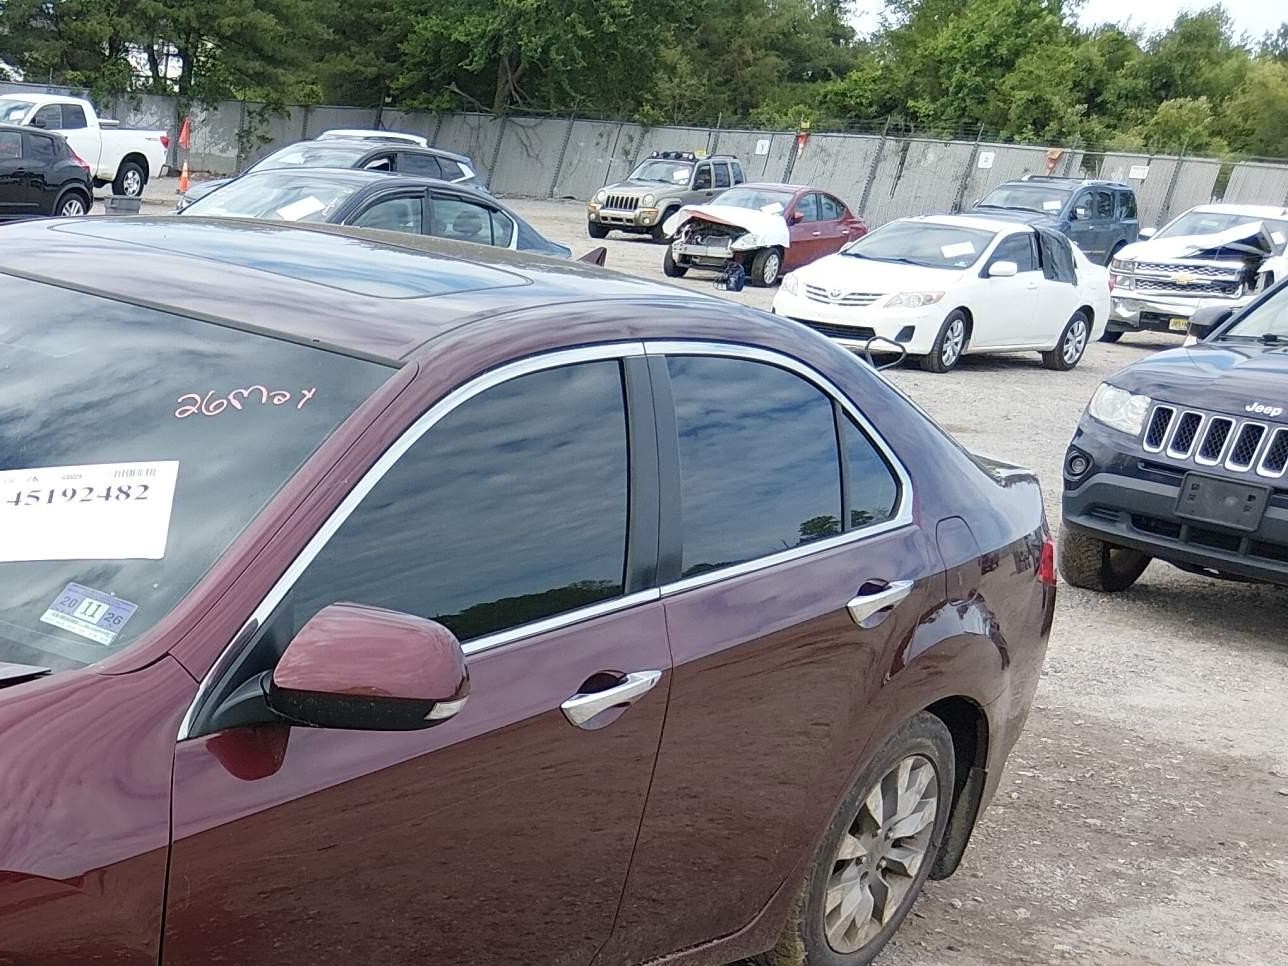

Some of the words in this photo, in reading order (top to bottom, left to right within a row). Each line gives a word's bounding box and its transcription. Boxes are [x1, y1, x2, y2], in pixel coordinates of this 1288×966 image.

[1245, 402, 1282, 417] Jeep
[7, 484, 149, 506] 45192482
[60, 596, 78, 608] 20
[80, 601, 102, 619] 11
[104, 612, 123, 625] 26
